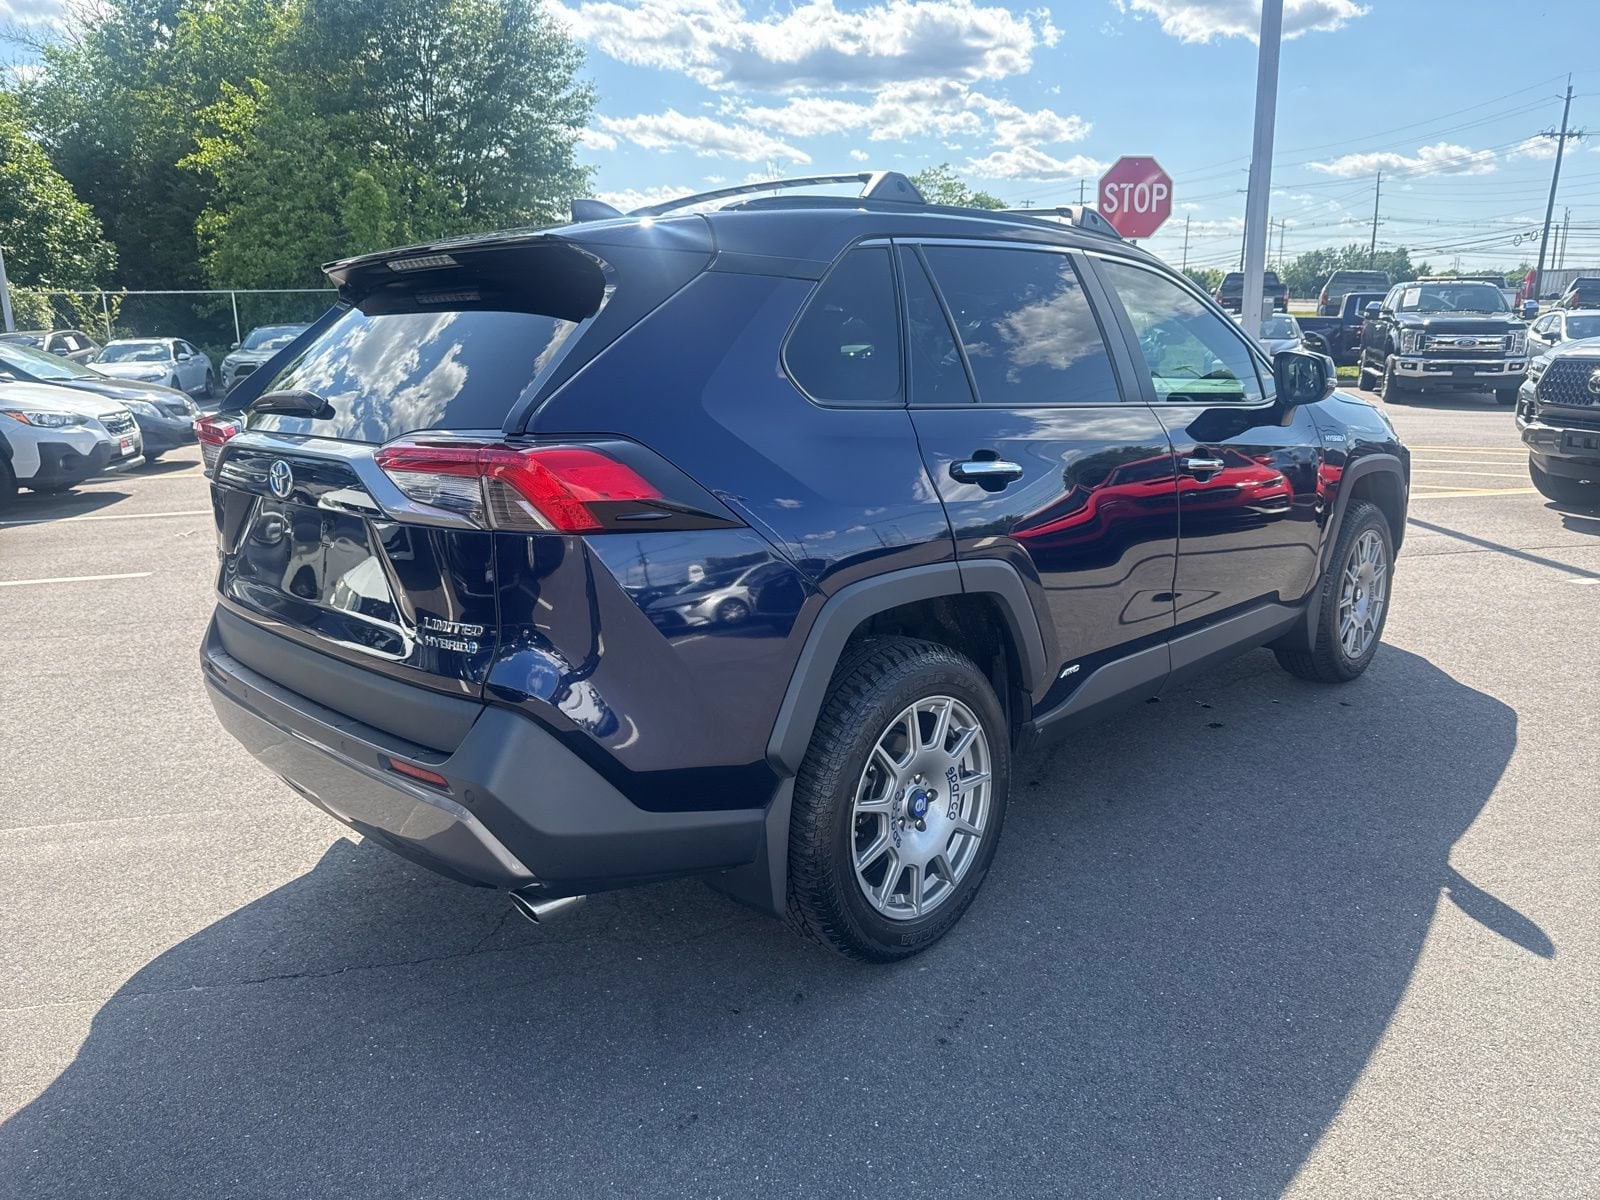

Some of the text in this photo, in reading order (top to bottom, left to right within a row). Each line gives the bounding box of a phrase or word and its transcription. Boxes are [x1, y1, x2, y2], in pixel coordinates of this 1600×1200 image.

[1103, 183, 1168, 213] STOP
[424, 617, 483, 637] LIMITED
[425, 635, 469, 652] HYBRID
[945, 766, 960, 821] sparco
